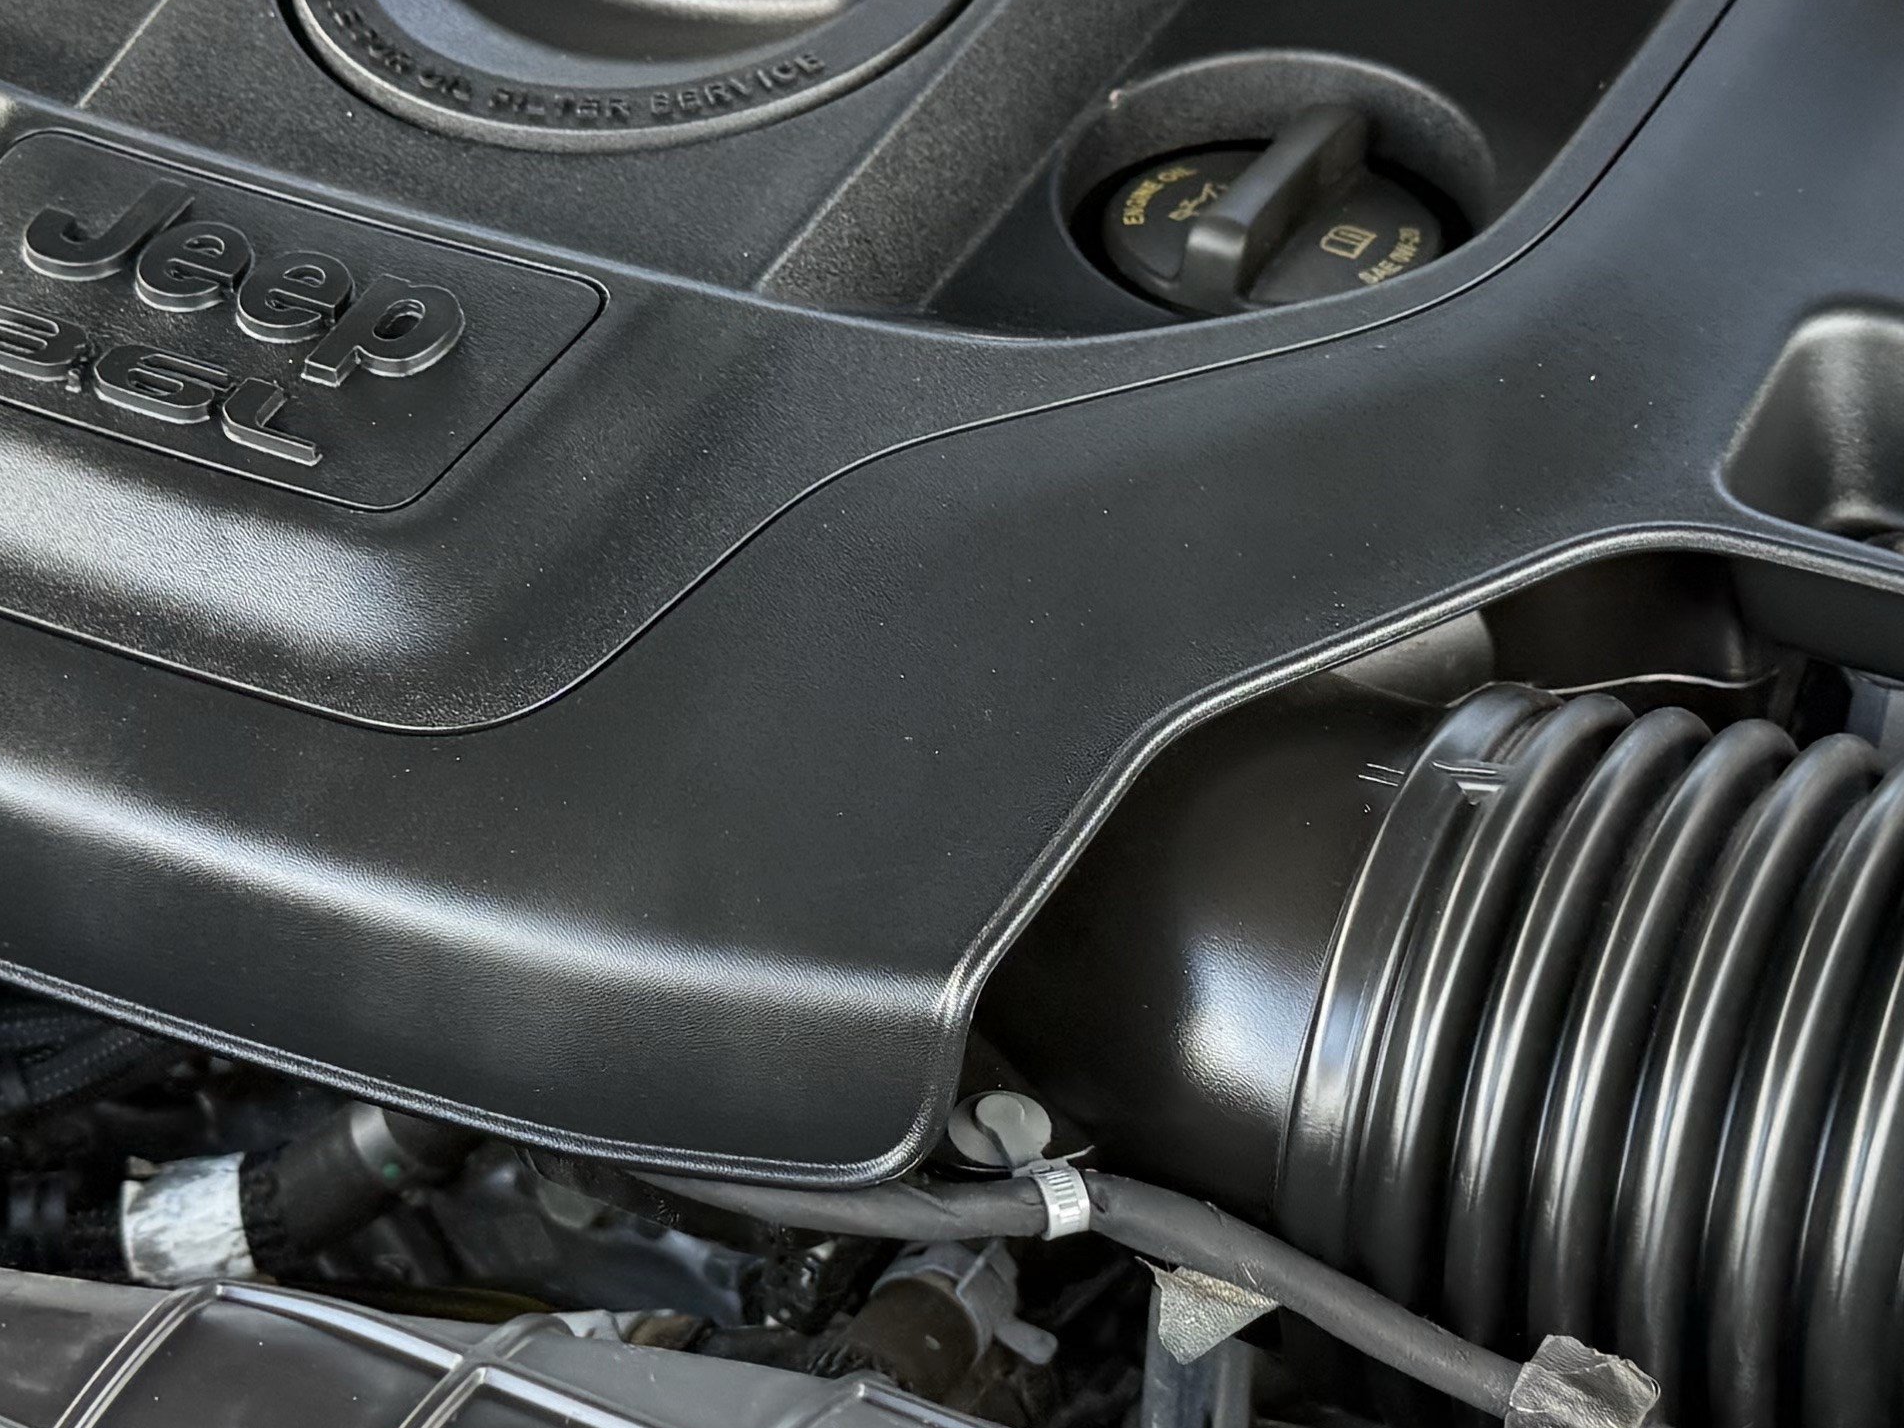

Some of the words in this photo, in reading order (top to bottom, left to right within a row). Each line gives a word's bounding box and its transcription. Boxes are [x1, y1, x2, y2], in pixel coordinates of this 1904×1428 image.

[487, 87, 630, 118] FILTER
[650, 50, 826, 115] SERVICE
[19, 177, 466, 387] Jeep
